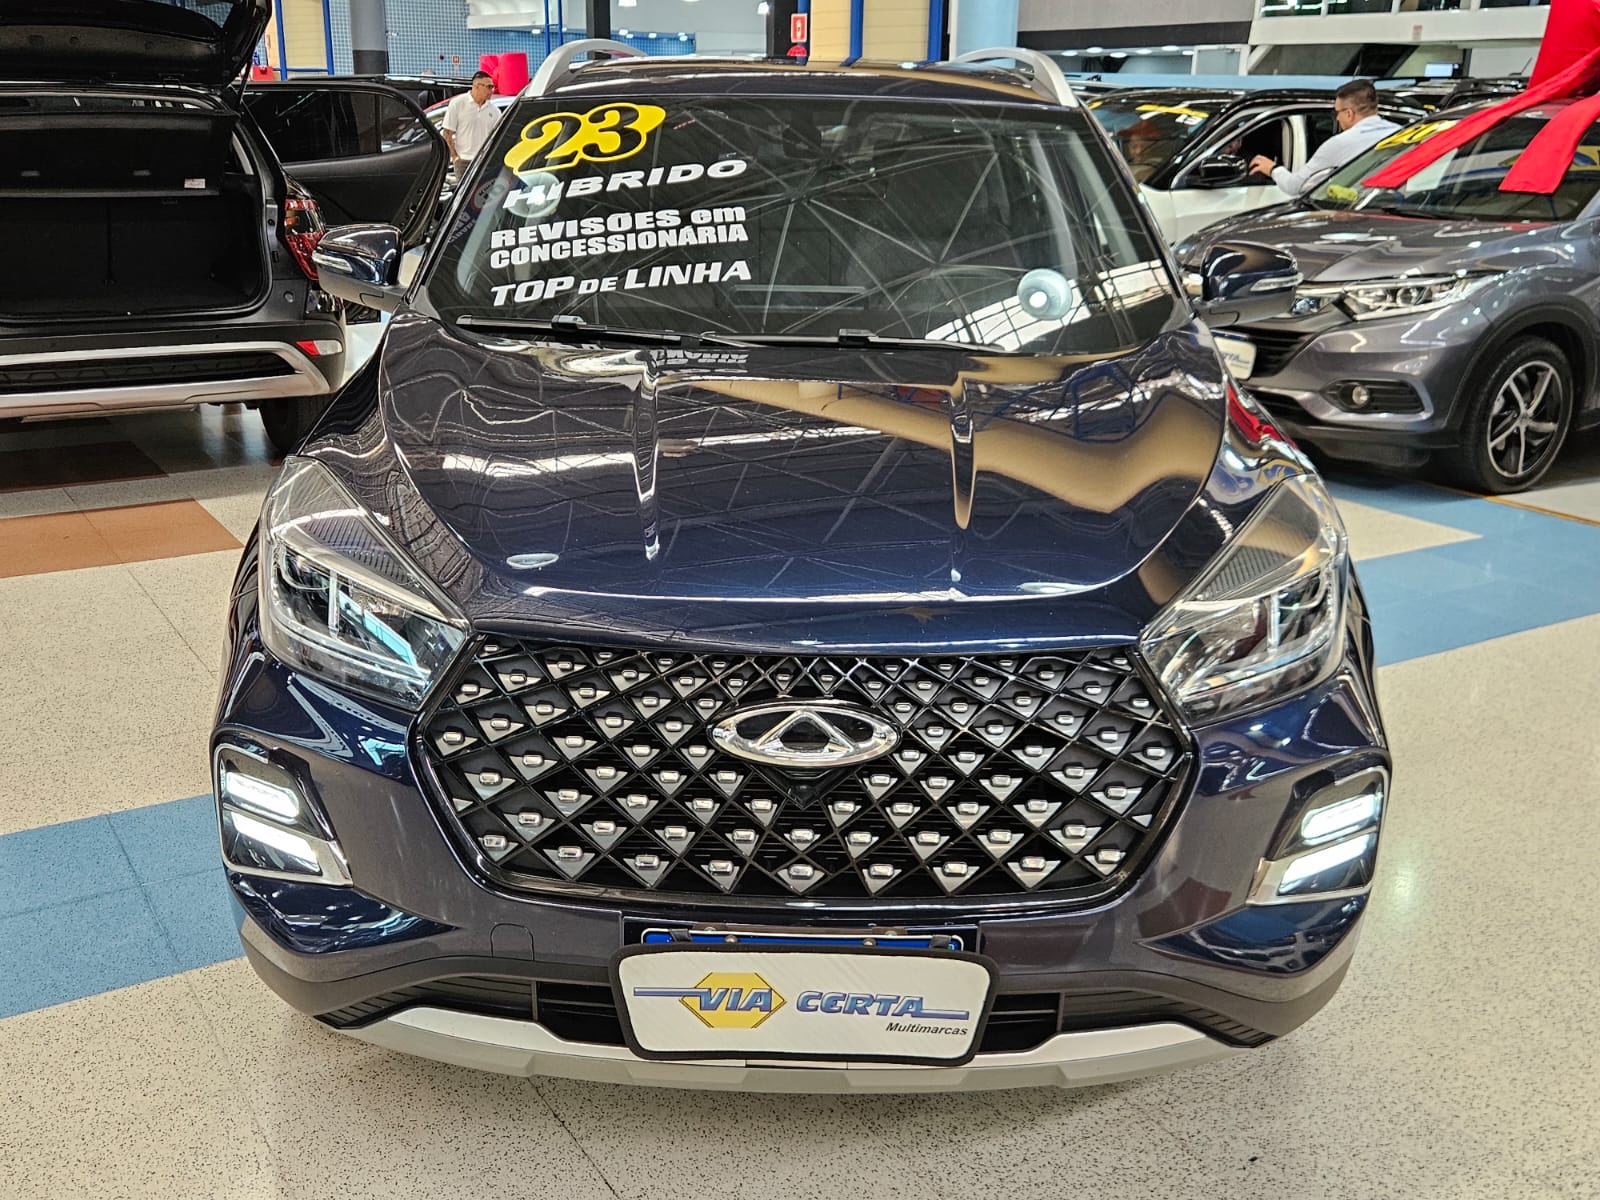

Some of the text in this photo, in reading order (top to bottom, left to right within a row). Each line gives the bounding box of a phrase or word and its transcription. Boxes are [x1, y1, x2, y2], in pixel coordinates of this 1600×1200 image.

[508, 103, 661, 174] 23
[691, 206, 747, 225] em
[489, 224, 749, 270] CONCESSIONÁRIA
[490, 260, 752, 307] TOP DE LINHA
[699, 987, 924, 1017] VIA CERTA
[885, 1022, 969, 1037] Multimarcas
